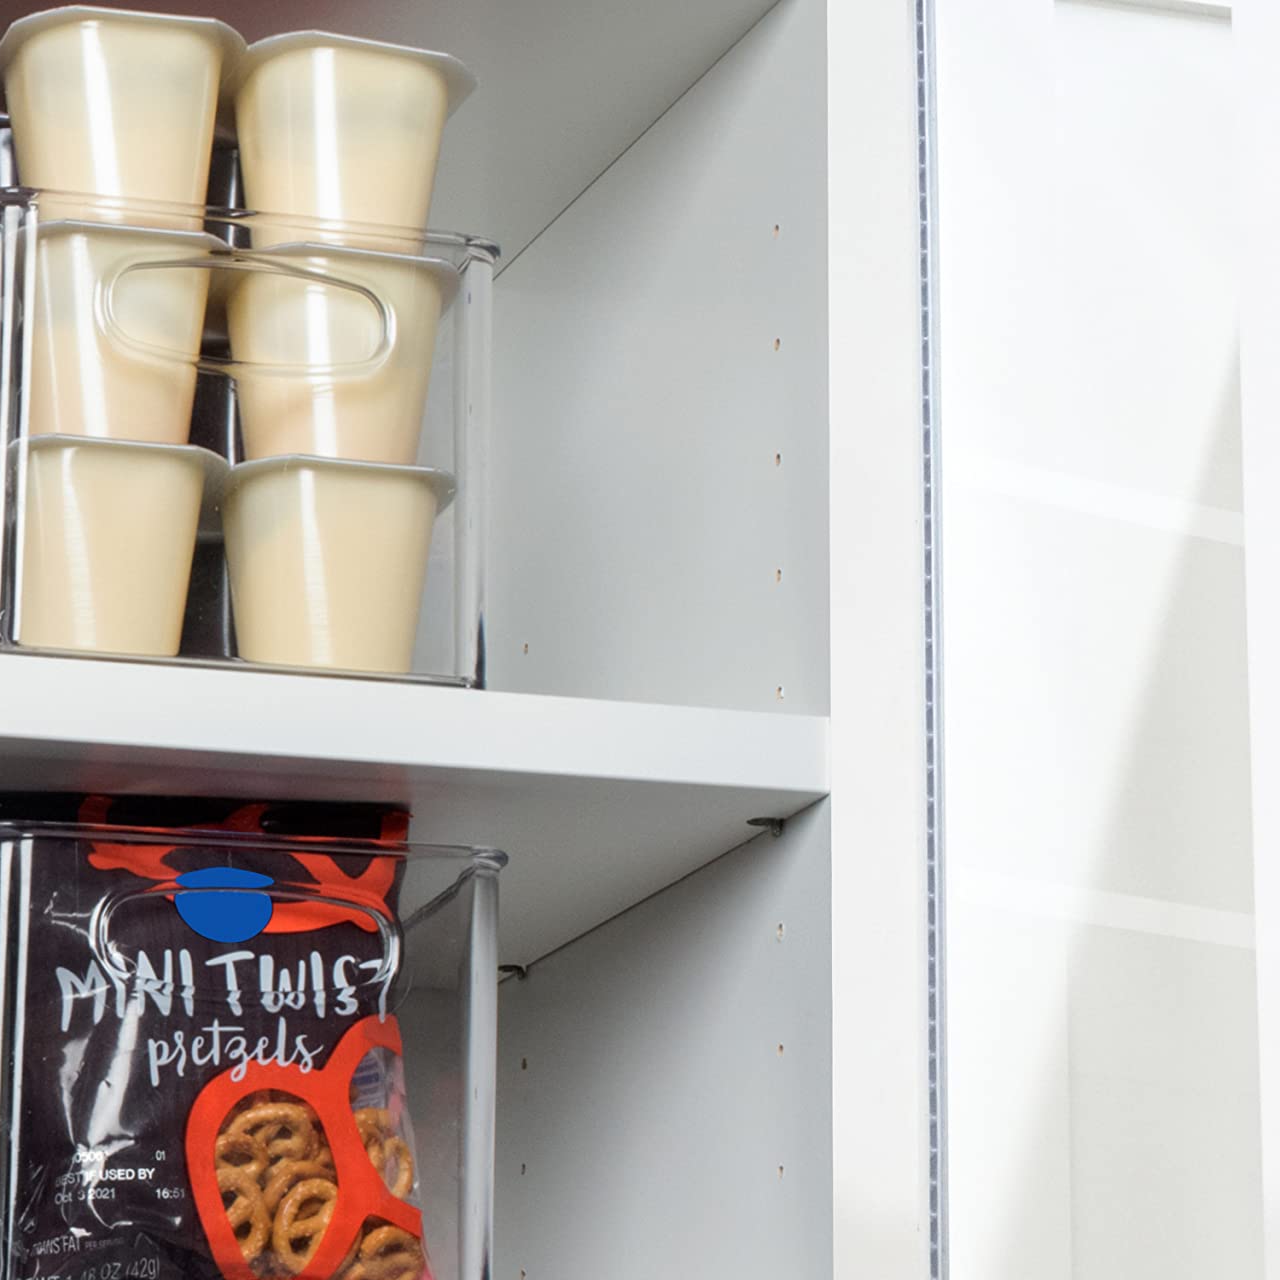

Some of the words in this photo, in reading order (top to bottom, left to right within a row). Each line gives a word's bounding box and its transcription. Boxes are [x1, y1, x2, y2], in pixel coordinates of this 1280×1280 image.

[55, 949, 194, 1032] MINI
[146, 1017, 324, 1087] pretzels
[100, 1168, 135, 1181] USED
[137, 1168, 156, 1180] BY
[88, 1187, 116, 1200] 2021
[62, 1235, 82, 1252] FAT
